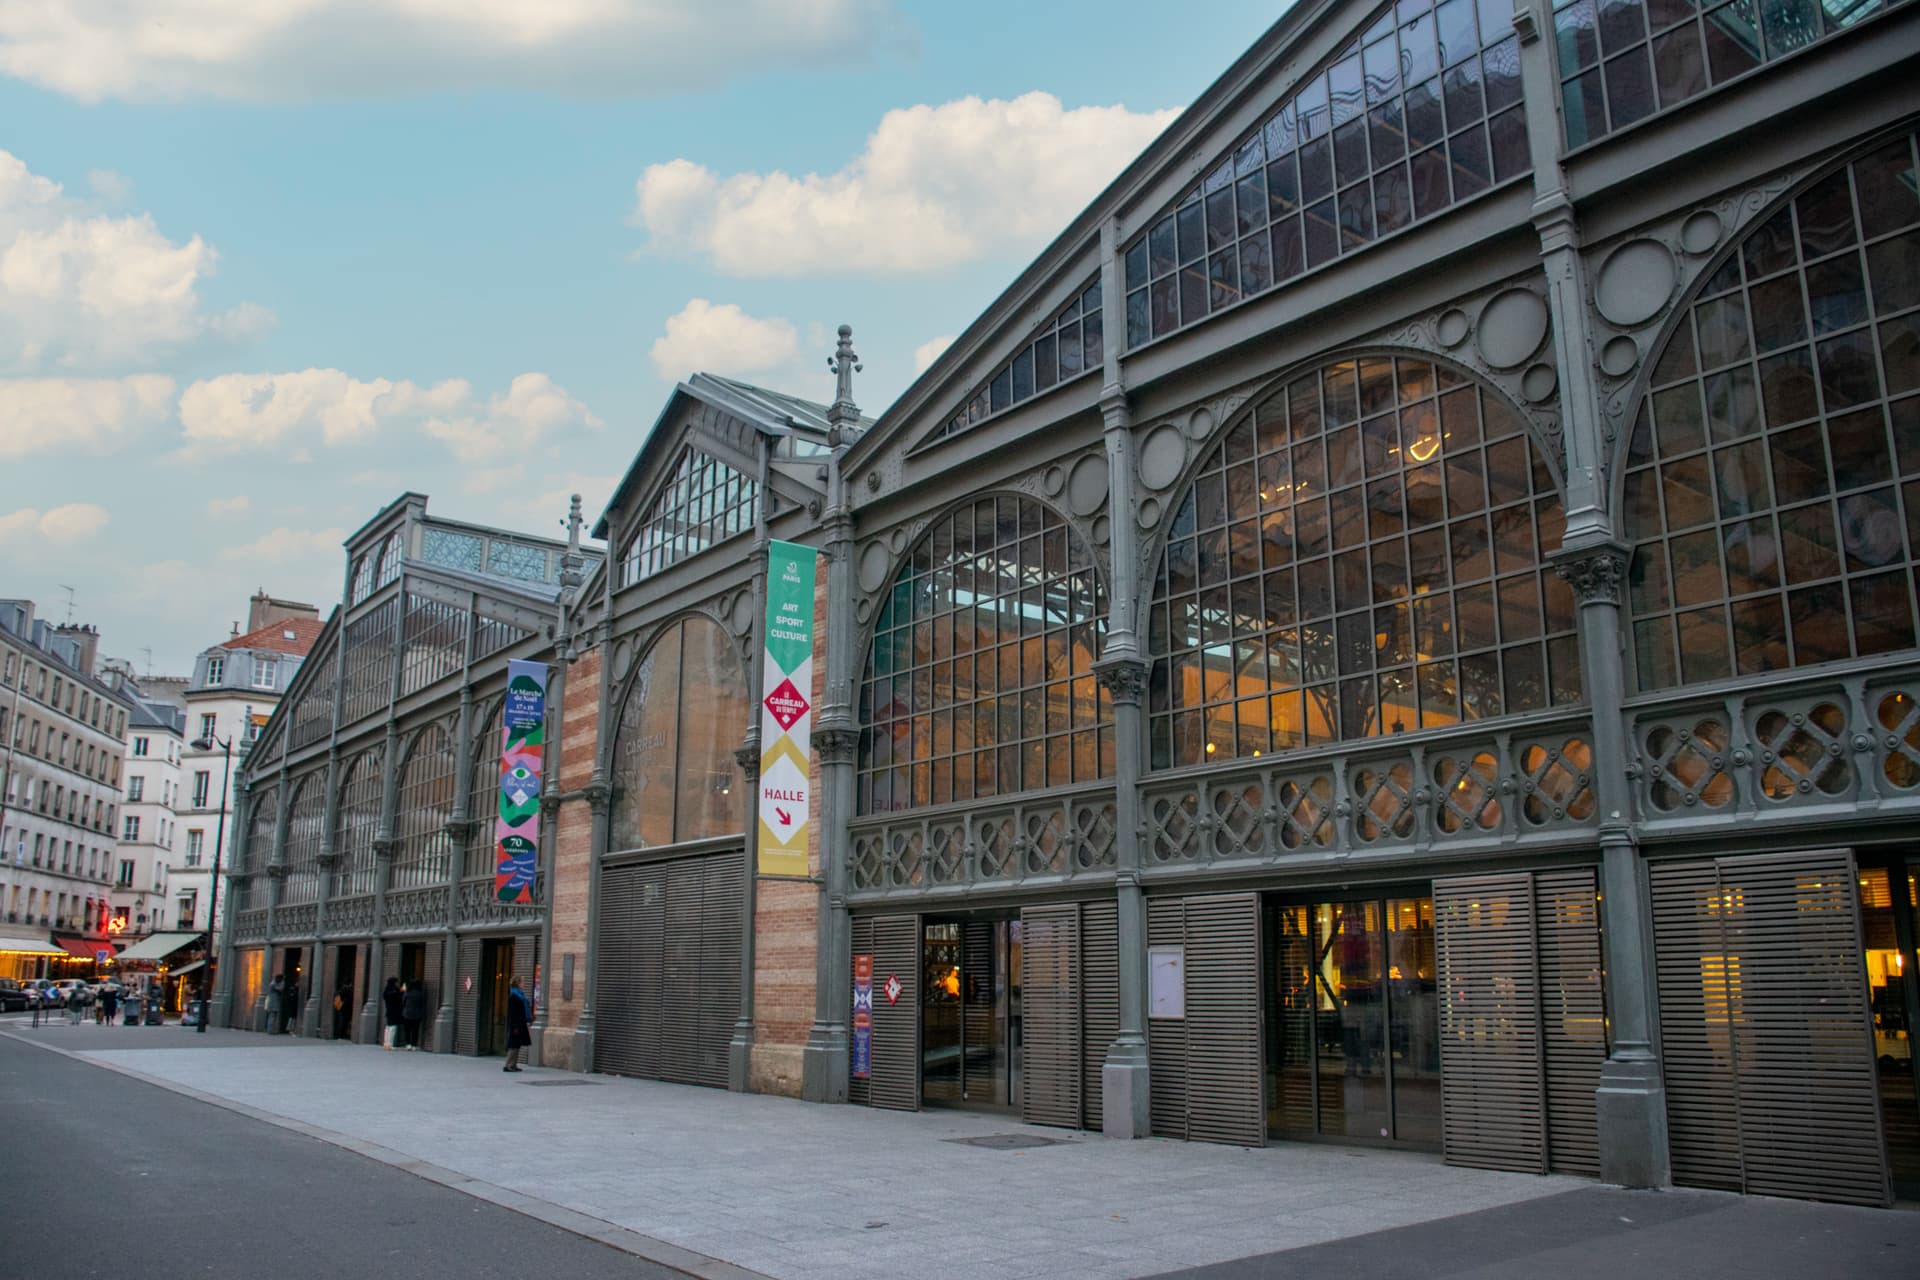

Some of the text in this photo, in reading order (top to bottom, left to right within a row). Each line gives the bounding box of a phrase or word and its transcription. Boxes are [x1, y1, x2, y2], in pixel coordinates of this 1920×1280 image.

[782, 602, 799, 612] ART
[775, 615, 804, 627] SPORT
[770, 628, 808, 642] CULTURE
[769, 696, 805, 708] CARREAU
[625, 730, 666, 756] CARREAU
[764, 788, 805, 802] HALLE
[510, 837, 523, 847] 70
